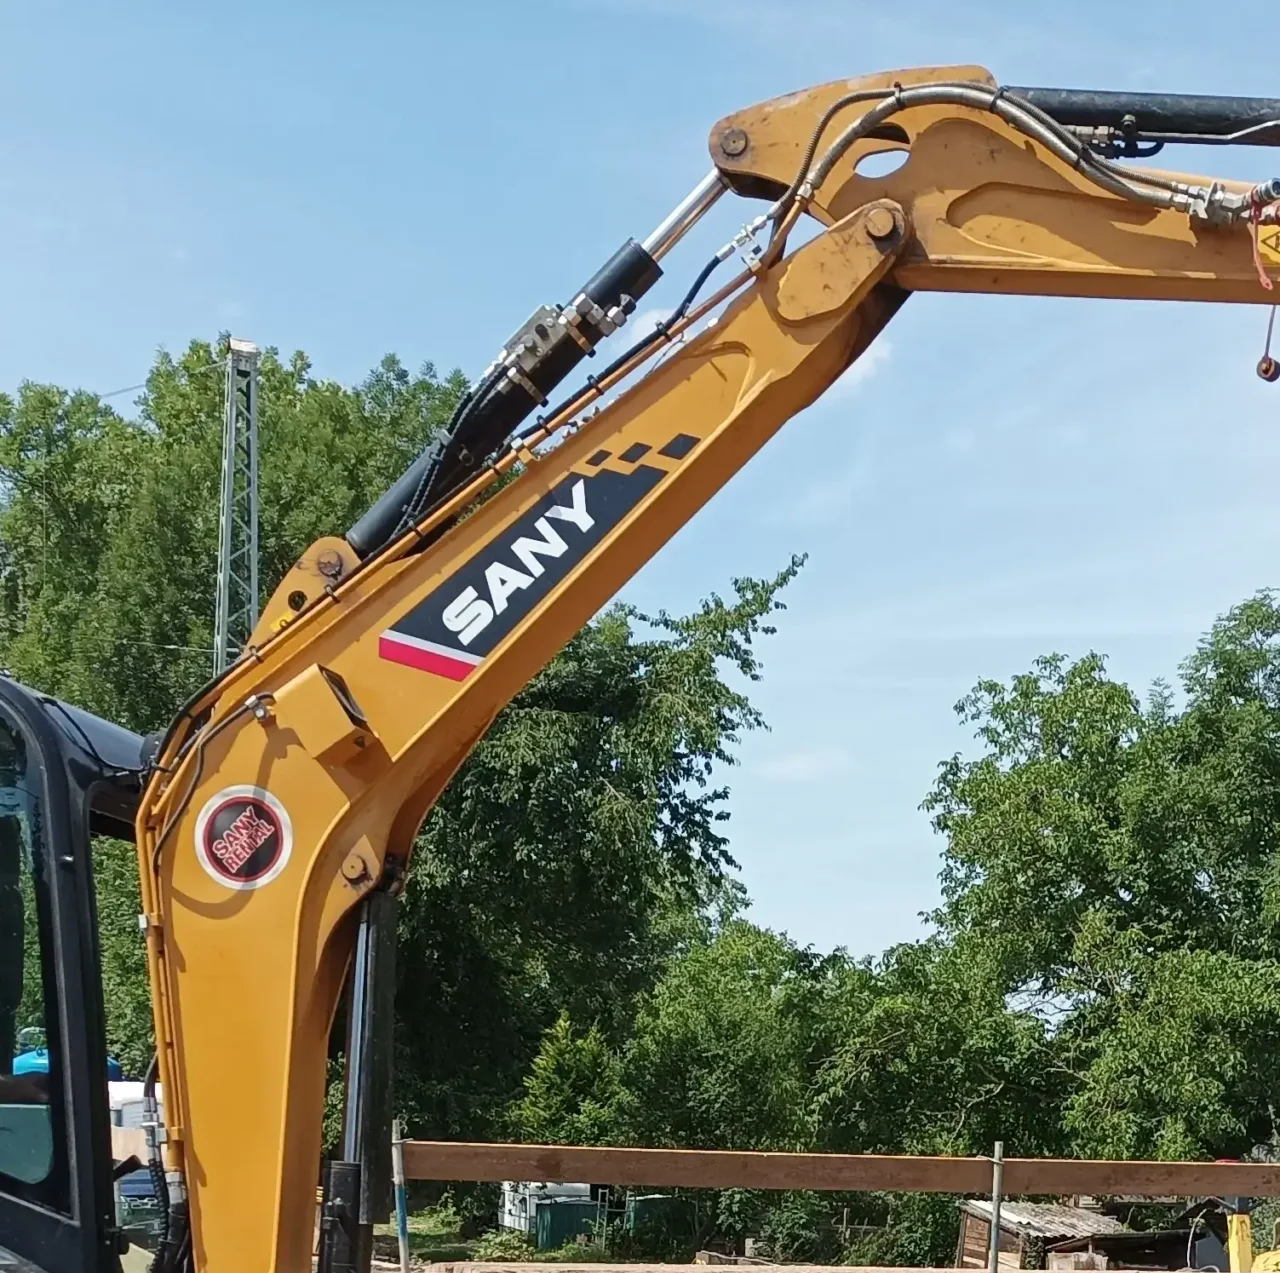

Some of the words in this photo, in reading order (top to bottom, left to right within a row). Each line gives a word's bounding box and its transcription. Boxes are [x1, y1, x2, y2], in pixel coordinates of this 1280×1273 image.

[442, 478, 595, 646] SANY
[212, 805, 259, 859] SANY
[222, 819, 275, 873] RENTAL
